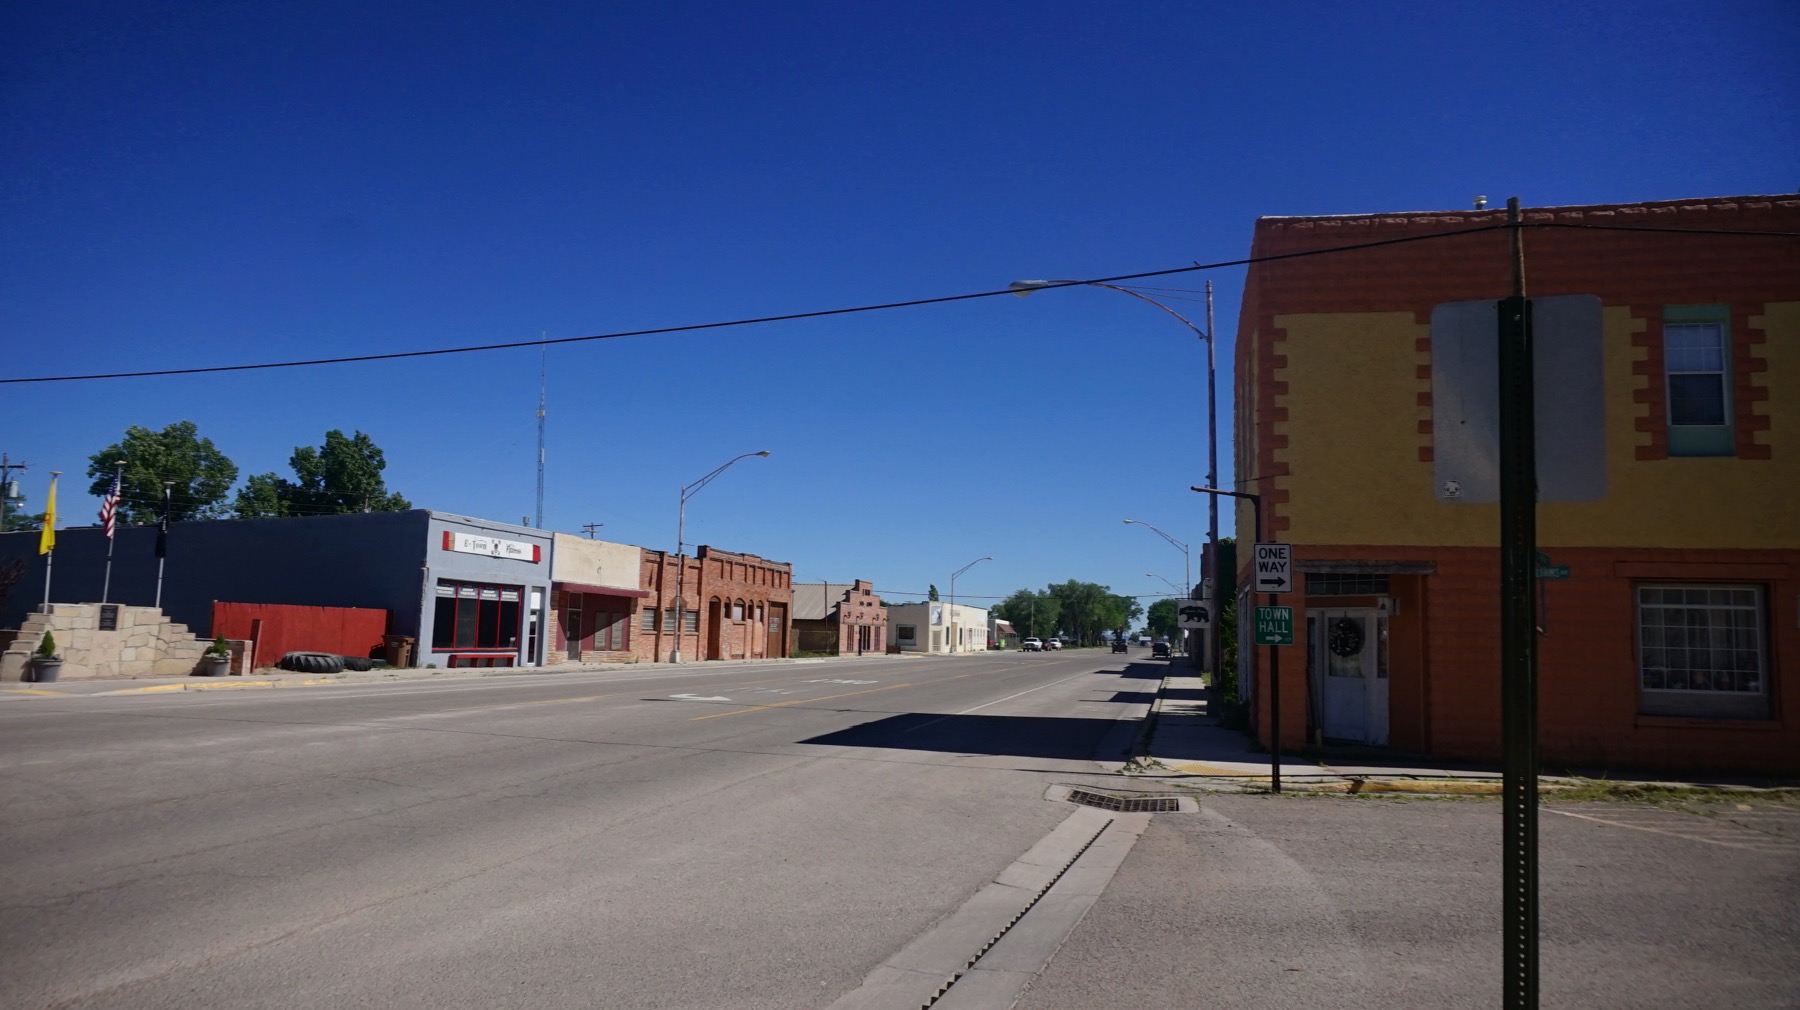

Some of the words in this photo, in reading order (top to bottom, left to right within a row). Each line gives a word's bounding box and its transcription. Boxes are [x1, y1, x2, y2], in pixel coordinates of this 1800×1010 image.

[1258, 547, 1287, 559] ONE
[1258, 561, 1287, 573] WAY
[1259, 608, 1289, 620] TOWN
[1259, 621, 1289, 633] HALL
